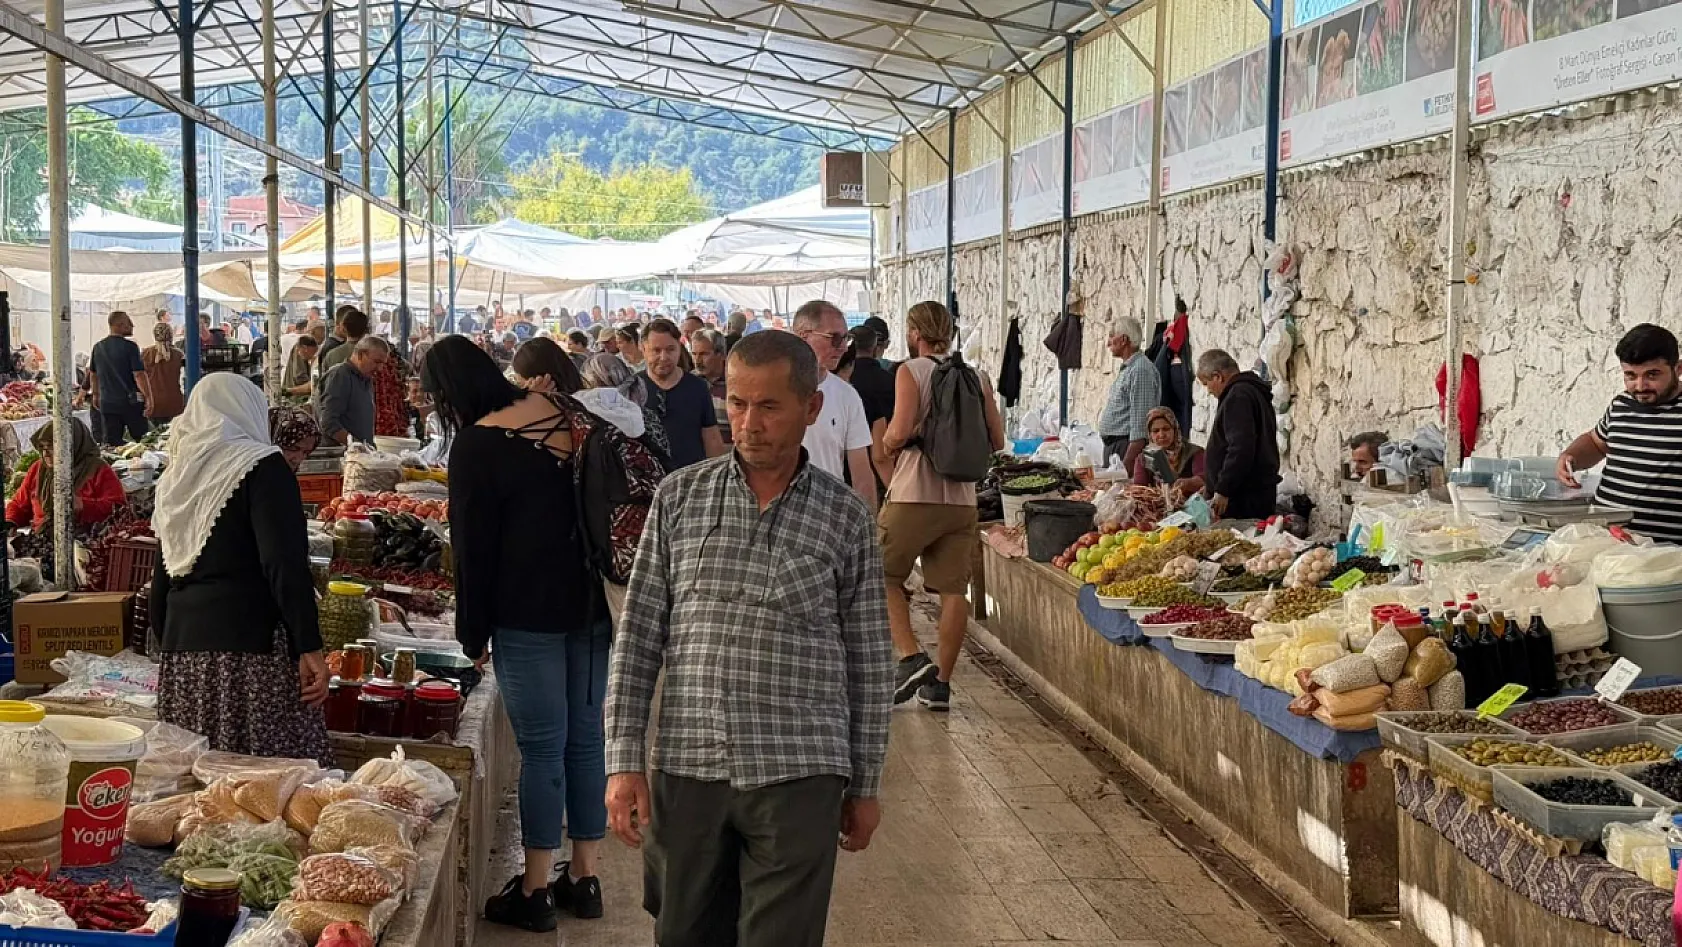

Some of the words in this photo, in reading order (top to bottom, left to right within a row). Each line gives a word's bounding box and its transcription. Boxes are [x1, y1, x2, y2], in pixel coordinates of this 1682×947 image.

[1564, 54, 1579, 67] Mart
[1579, 49, 1600, 65] Dünya
[1656, 27, 1677, 45] Günü
[1652, 51, 1676, 67] Canan
[44, 640, 65, 652] SPLIT
[83, 638, 114, 650] LENTILS
[1347, 762, 1367, 791] 8
